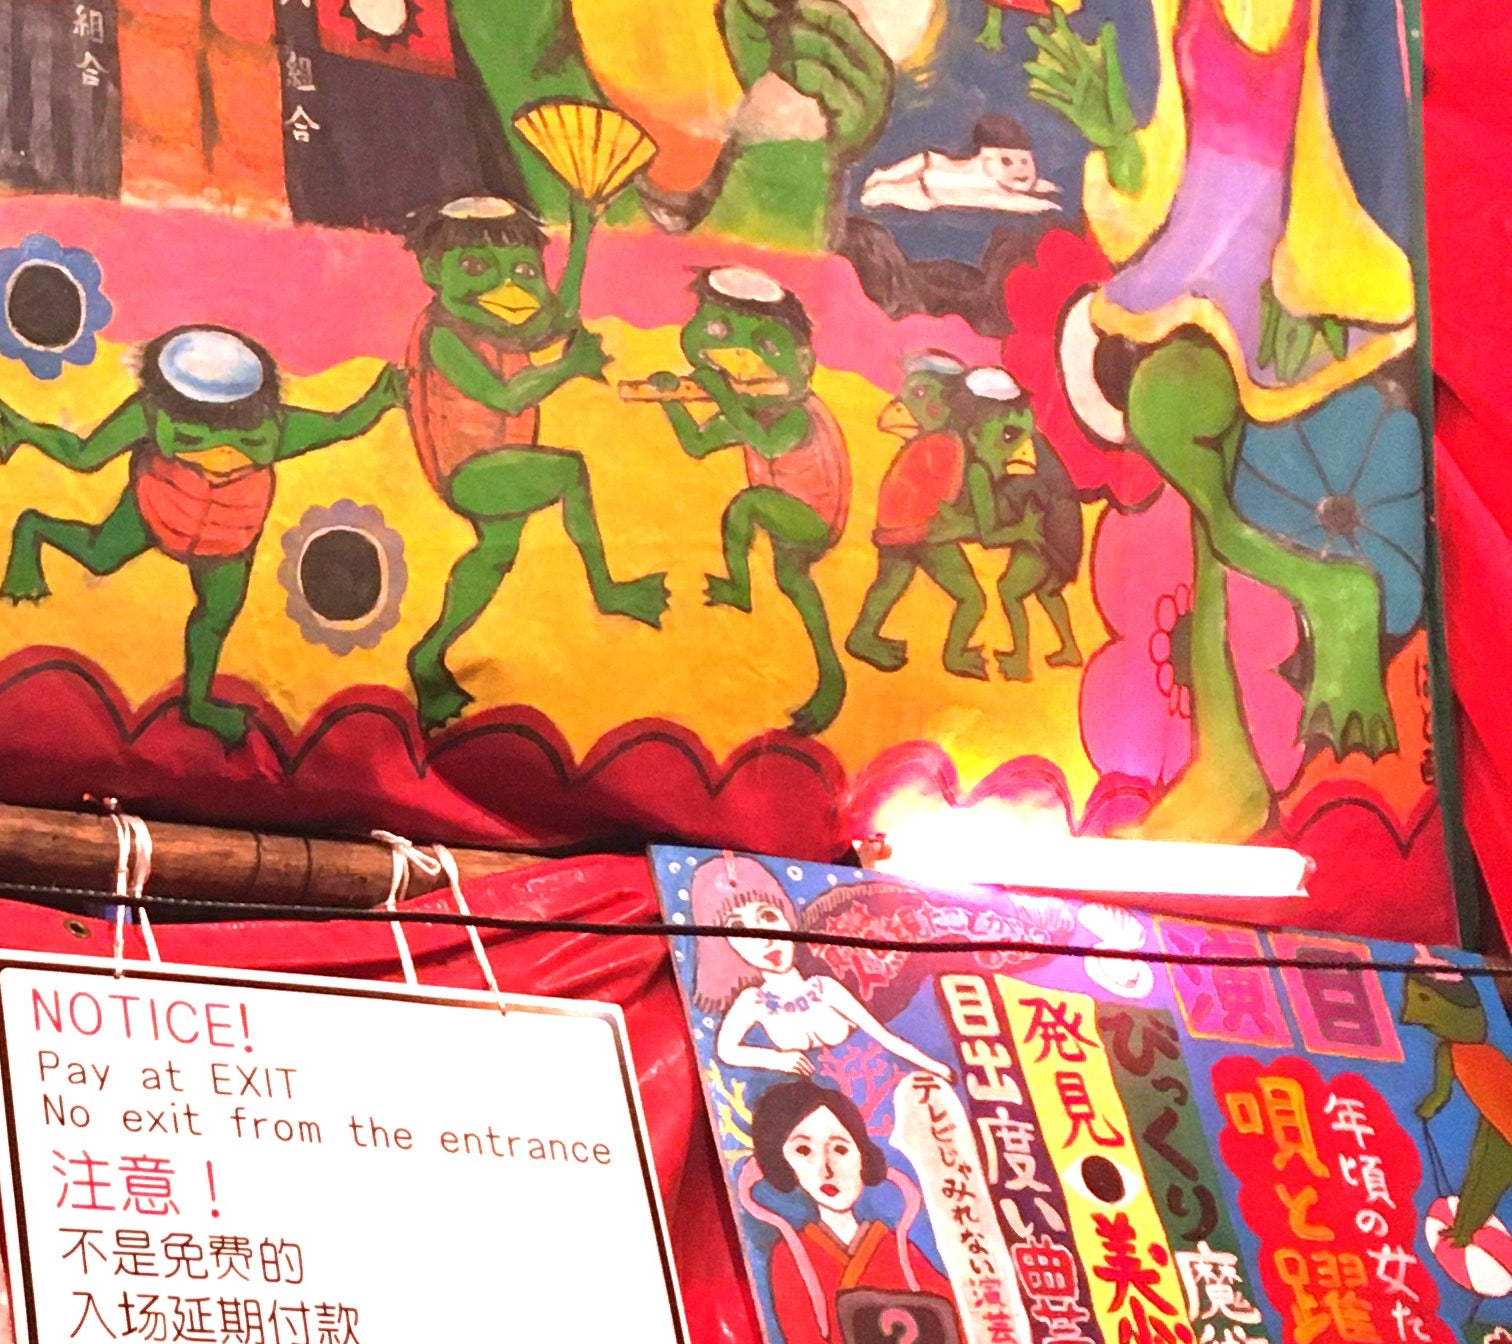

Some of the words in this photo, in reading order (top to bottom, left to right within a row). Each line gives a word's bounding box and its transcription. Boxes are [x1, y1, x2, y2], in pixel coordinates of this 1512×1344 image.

[31, 987, 254, 1054] NOTICE!
[38, 1050, 110, 1092] Pay
[141, 1065, 185, 1094] at
[212, 1063, 299, 1100] EXIT
[43, 1094, 90, 1130] No
[122, 1103, 203, 1138] exit
[230, 1107, 322, 1145] from
[349, 1118, 414, 1151] the
[440, 1127, 613, 1166] entrance
[58, 1227, 304, 1286] 不是免费的
